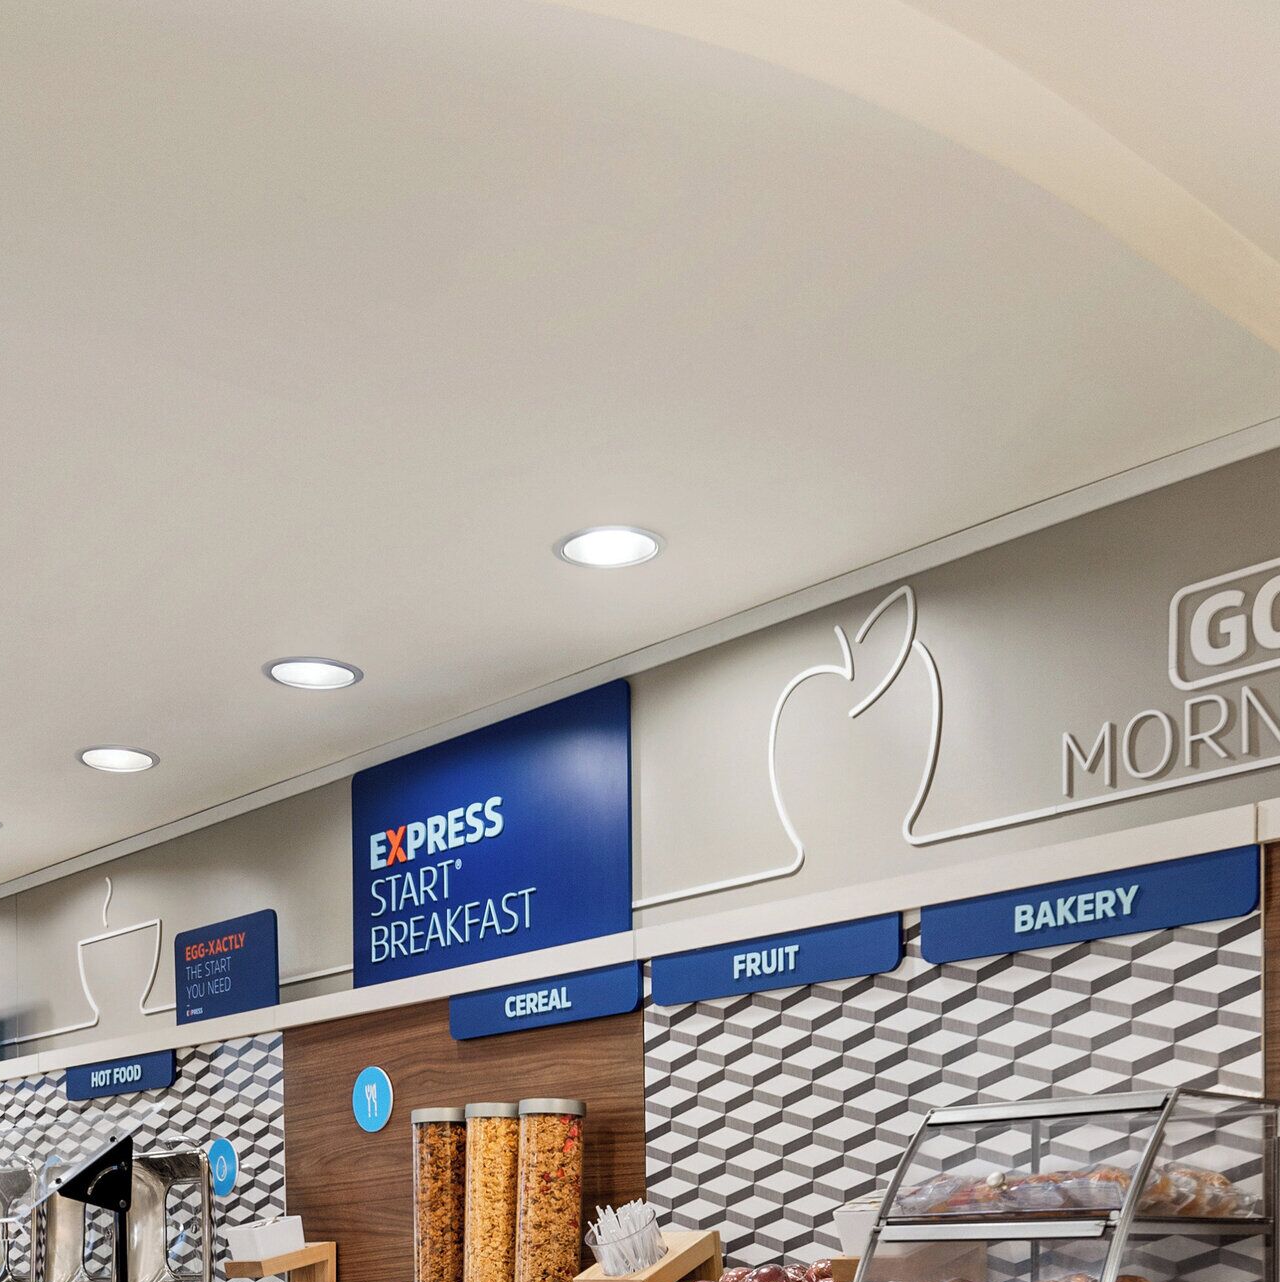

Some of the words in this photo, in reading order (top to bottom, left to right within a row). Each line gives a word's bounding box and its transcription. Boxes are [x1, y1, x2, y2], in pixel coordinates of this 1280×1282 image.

[370, 795, 504, 871] EXPRESS
[371, 887, 537, 963] BREAKFAST
[1014, 884, 1140, 934] BAKERY
[185, 932, 246, 961] EGG-XACTLY
[732, 944, 799, 980] FRUIT
[185, 963, 203, 981] THE
[205, 956, 232, 977] START
[186, 982, 205, 1000] YOU
[207, 976, 232, 995] NEED
[504, 986, 572, 1019] CEREAL
[91, 1069, 112, 1088] HOT
[113, 1064, 142, 1085] FOOD
